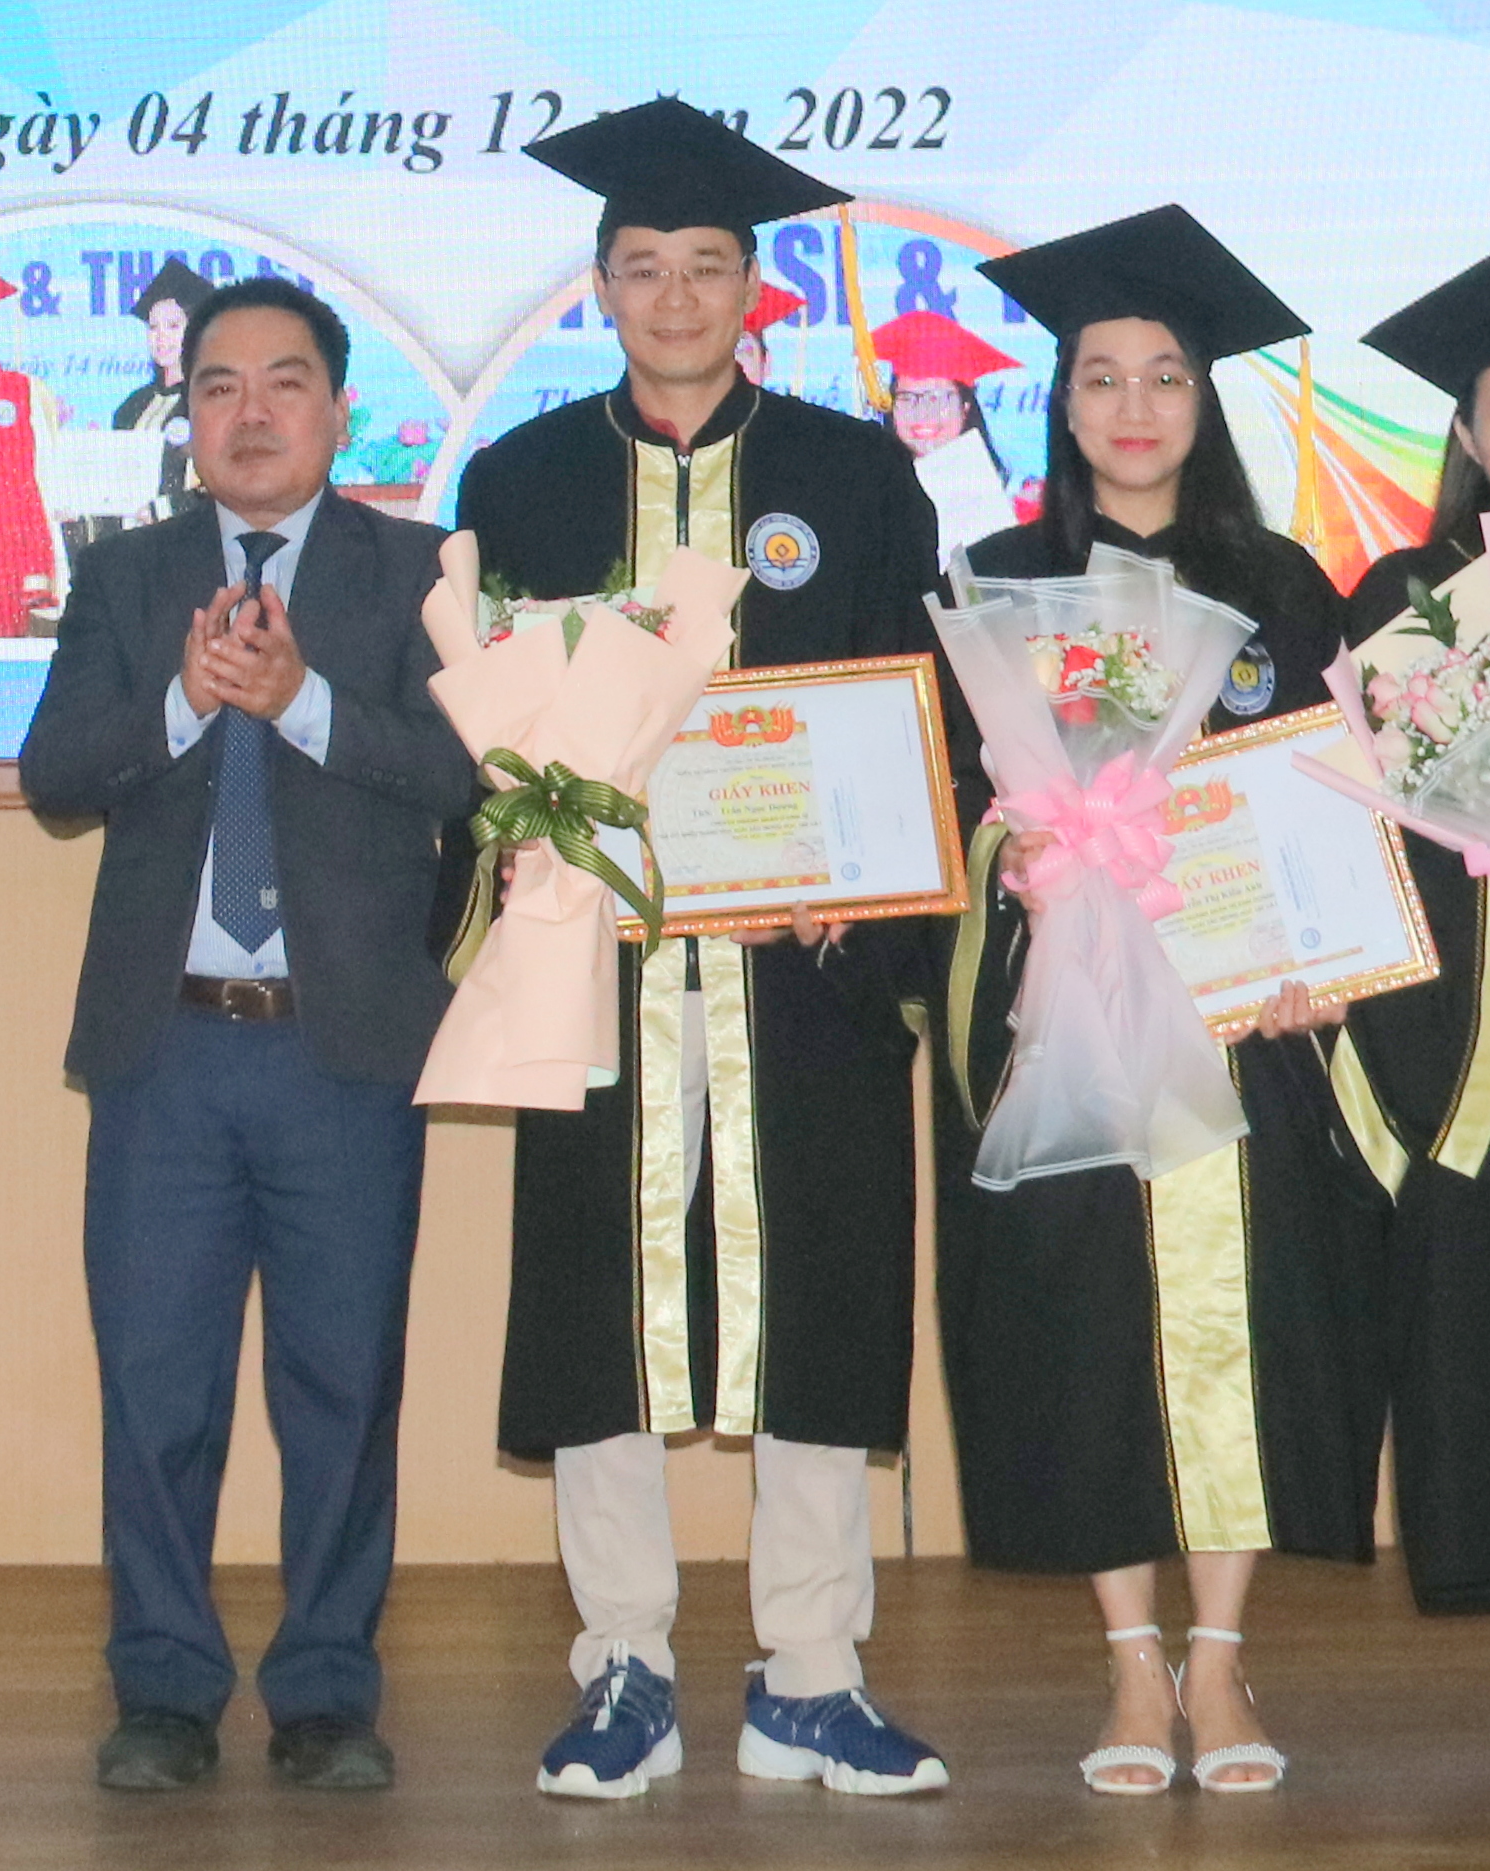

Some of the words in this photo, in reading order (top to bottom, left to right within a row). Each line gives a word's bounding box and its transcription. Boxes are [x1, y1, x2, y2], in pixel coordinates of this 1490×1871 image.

[127, 90, 212, 157] 04
[238, 88, 453, 174] tháng
[478, 90, 566, 156] 12
[774, 85, 954, 154] 2022
[21, 259, 63, 318] &
[894, 238, 959, 323] &
[759, 781, 811, 797] KHEN
[1209, 859, 1263, 885] KHEN
